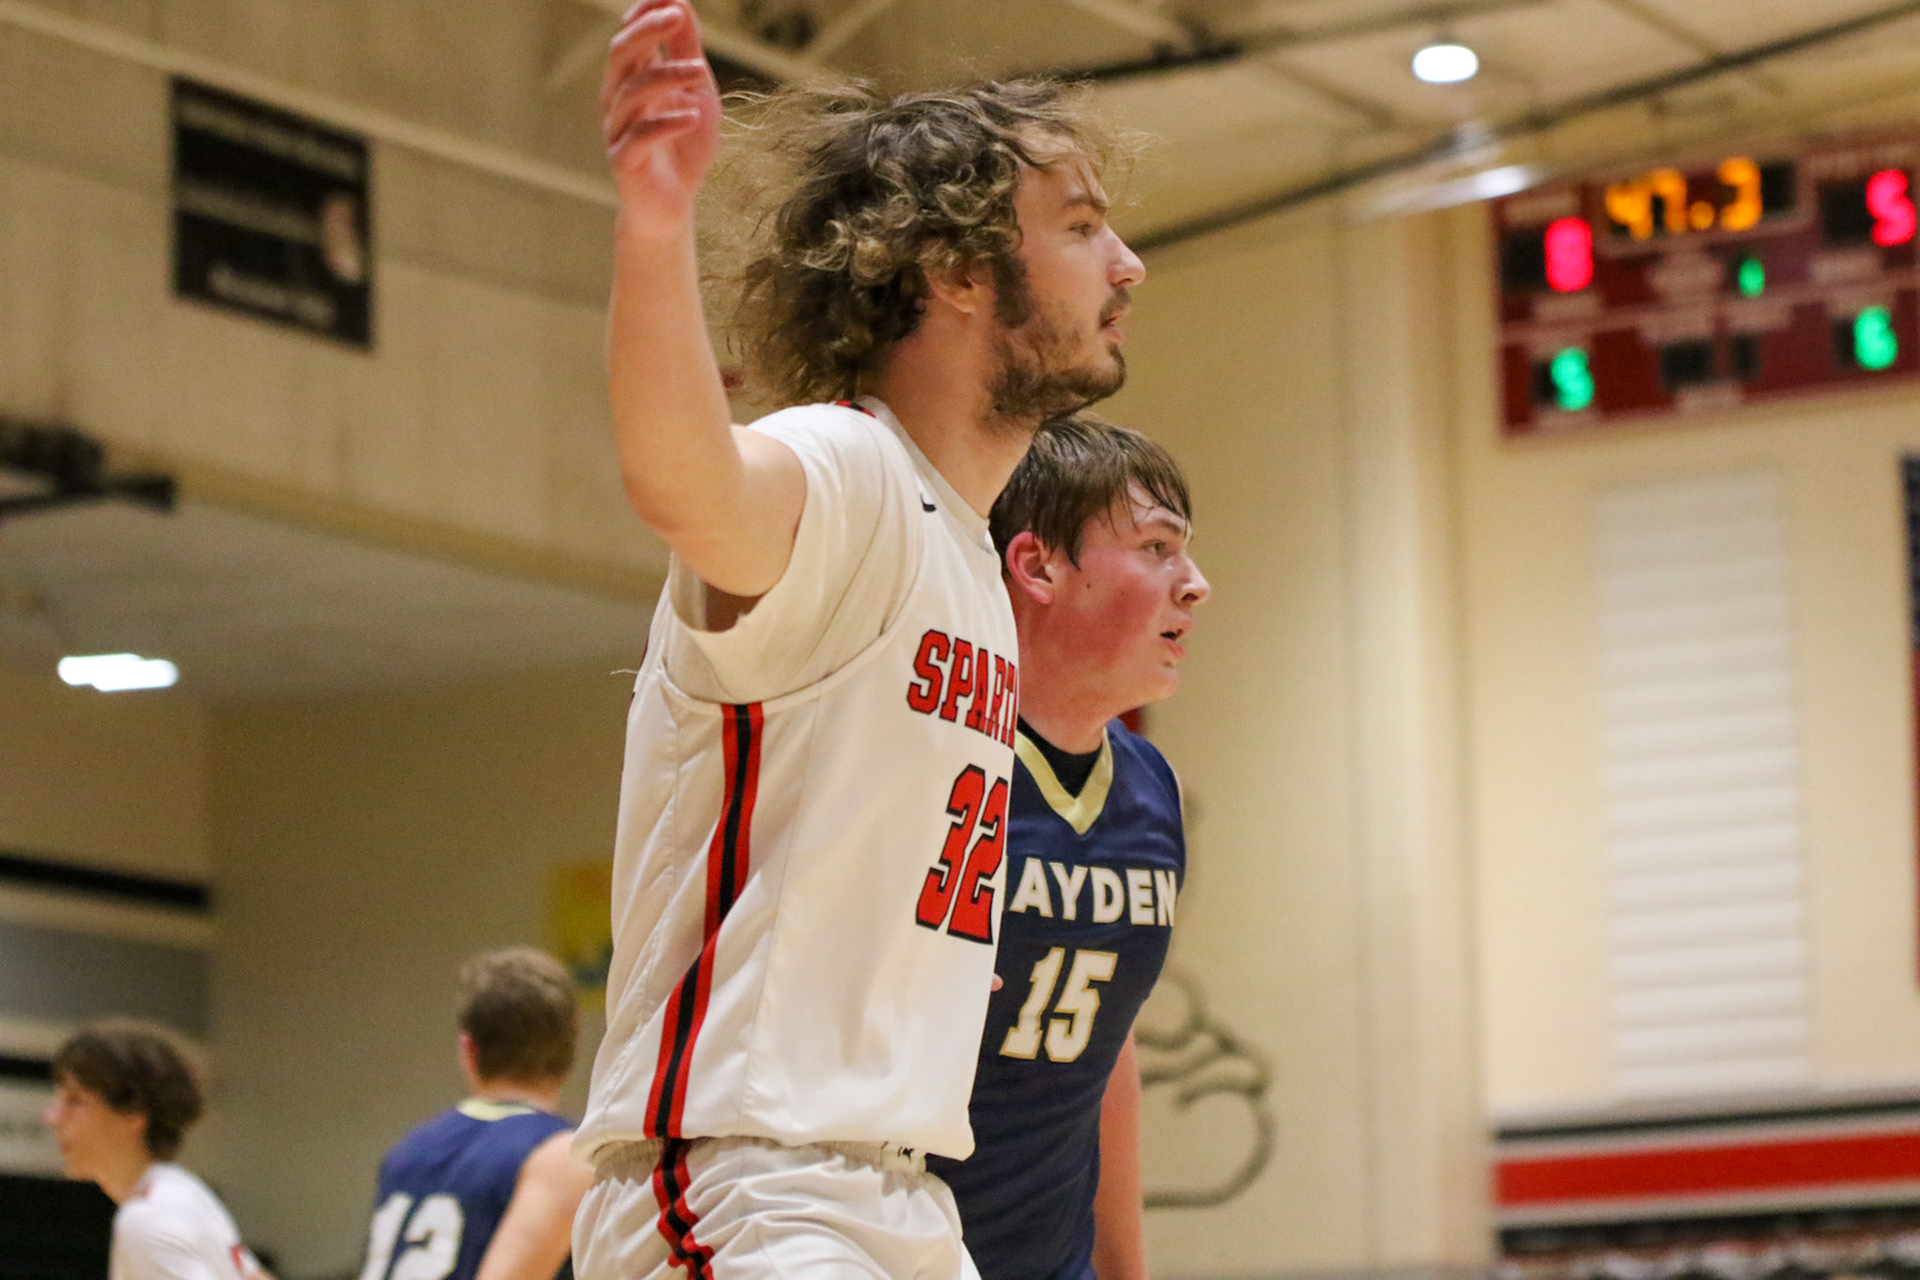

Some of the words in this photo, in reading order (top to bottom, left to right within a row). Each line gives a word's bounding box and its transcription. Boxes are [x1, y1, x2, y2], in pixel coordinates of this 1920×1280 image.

[915, 763, 1009, 945] 32
[998, 946, 1119, 1063] 15
[359, 1191, 467, 1280] 12
